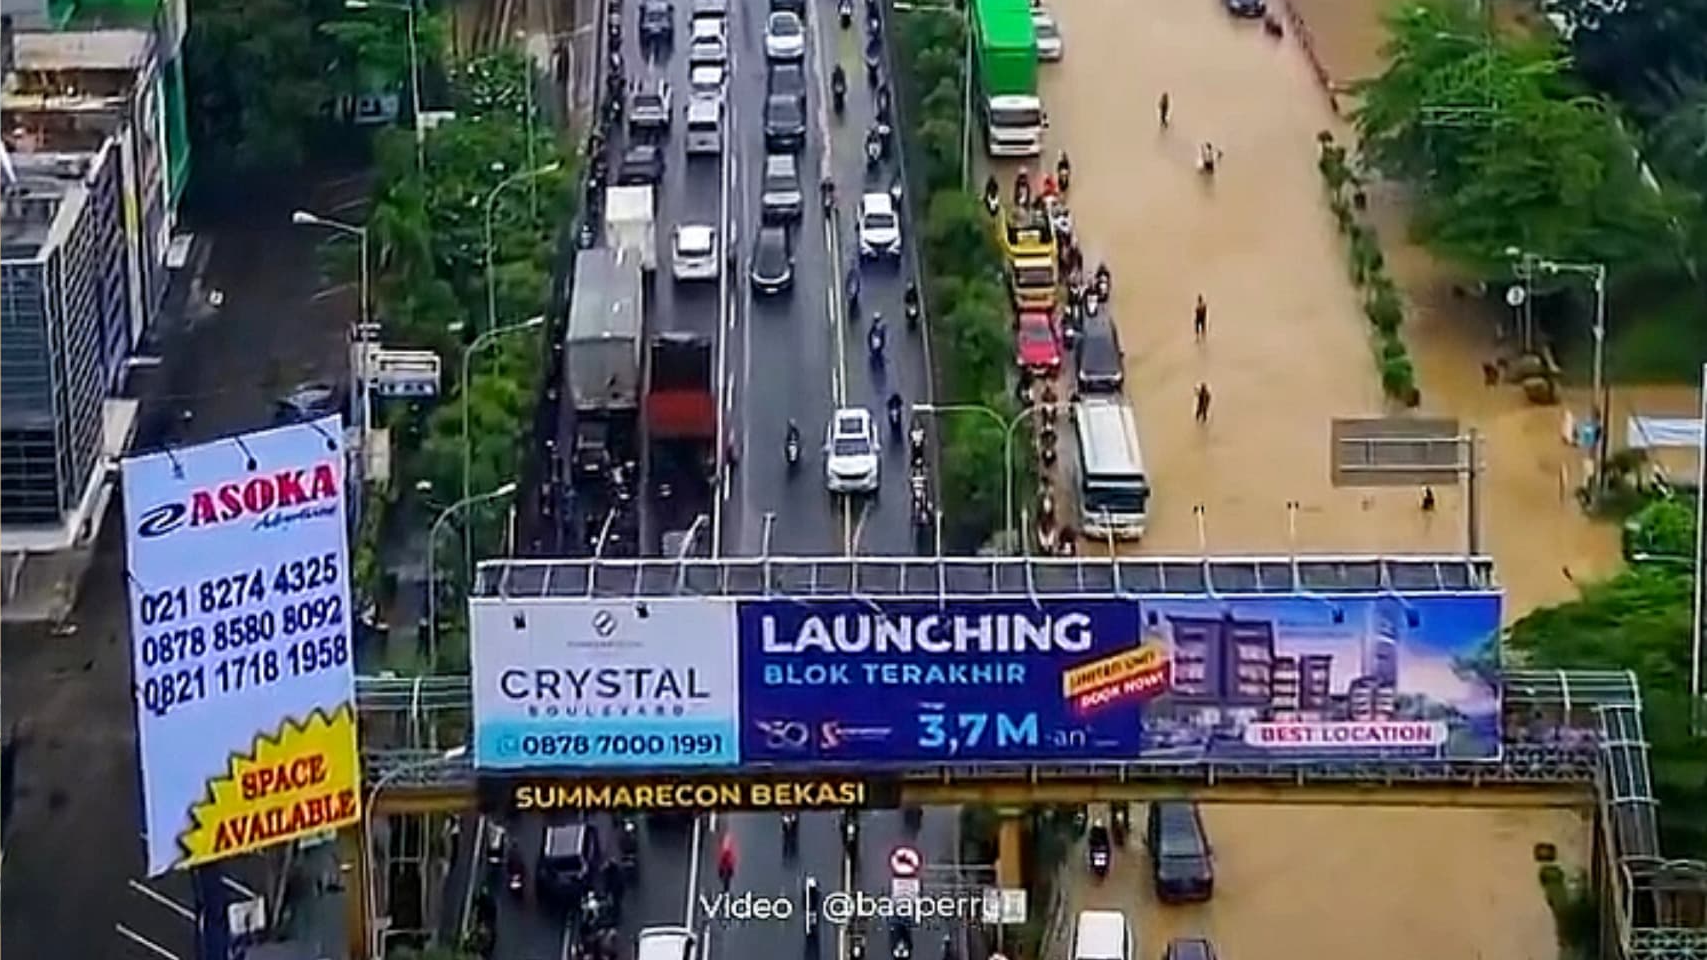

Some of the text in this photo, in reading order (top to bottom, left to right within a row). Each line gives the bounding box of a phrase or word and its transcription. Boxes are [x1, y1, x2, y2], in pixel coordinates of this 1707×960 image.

[190, 464, 338, 527] ASOKA
[141, 553, 337, 626] 021 8274 4325
[143, 595, 342, 667] 0878 8580 8092
[762, 612, 1092, 653] LAUNCHING
[144, 635, 348, 711] 0821 1718 1958
[500, 667, 711, 700] CRYSTAL
[764, 663, 1026, 685] BLOK TERAKHIR
[528, 705, 685, 718] BOULEVARD
[522, 734, 723, 755] 0878 7000 1991
[1260, 725, 1432, 742] BEST LOCATION
[242, 754, 327, 800] SPACE
[213, 790, 356, 853] AVAILABLE
